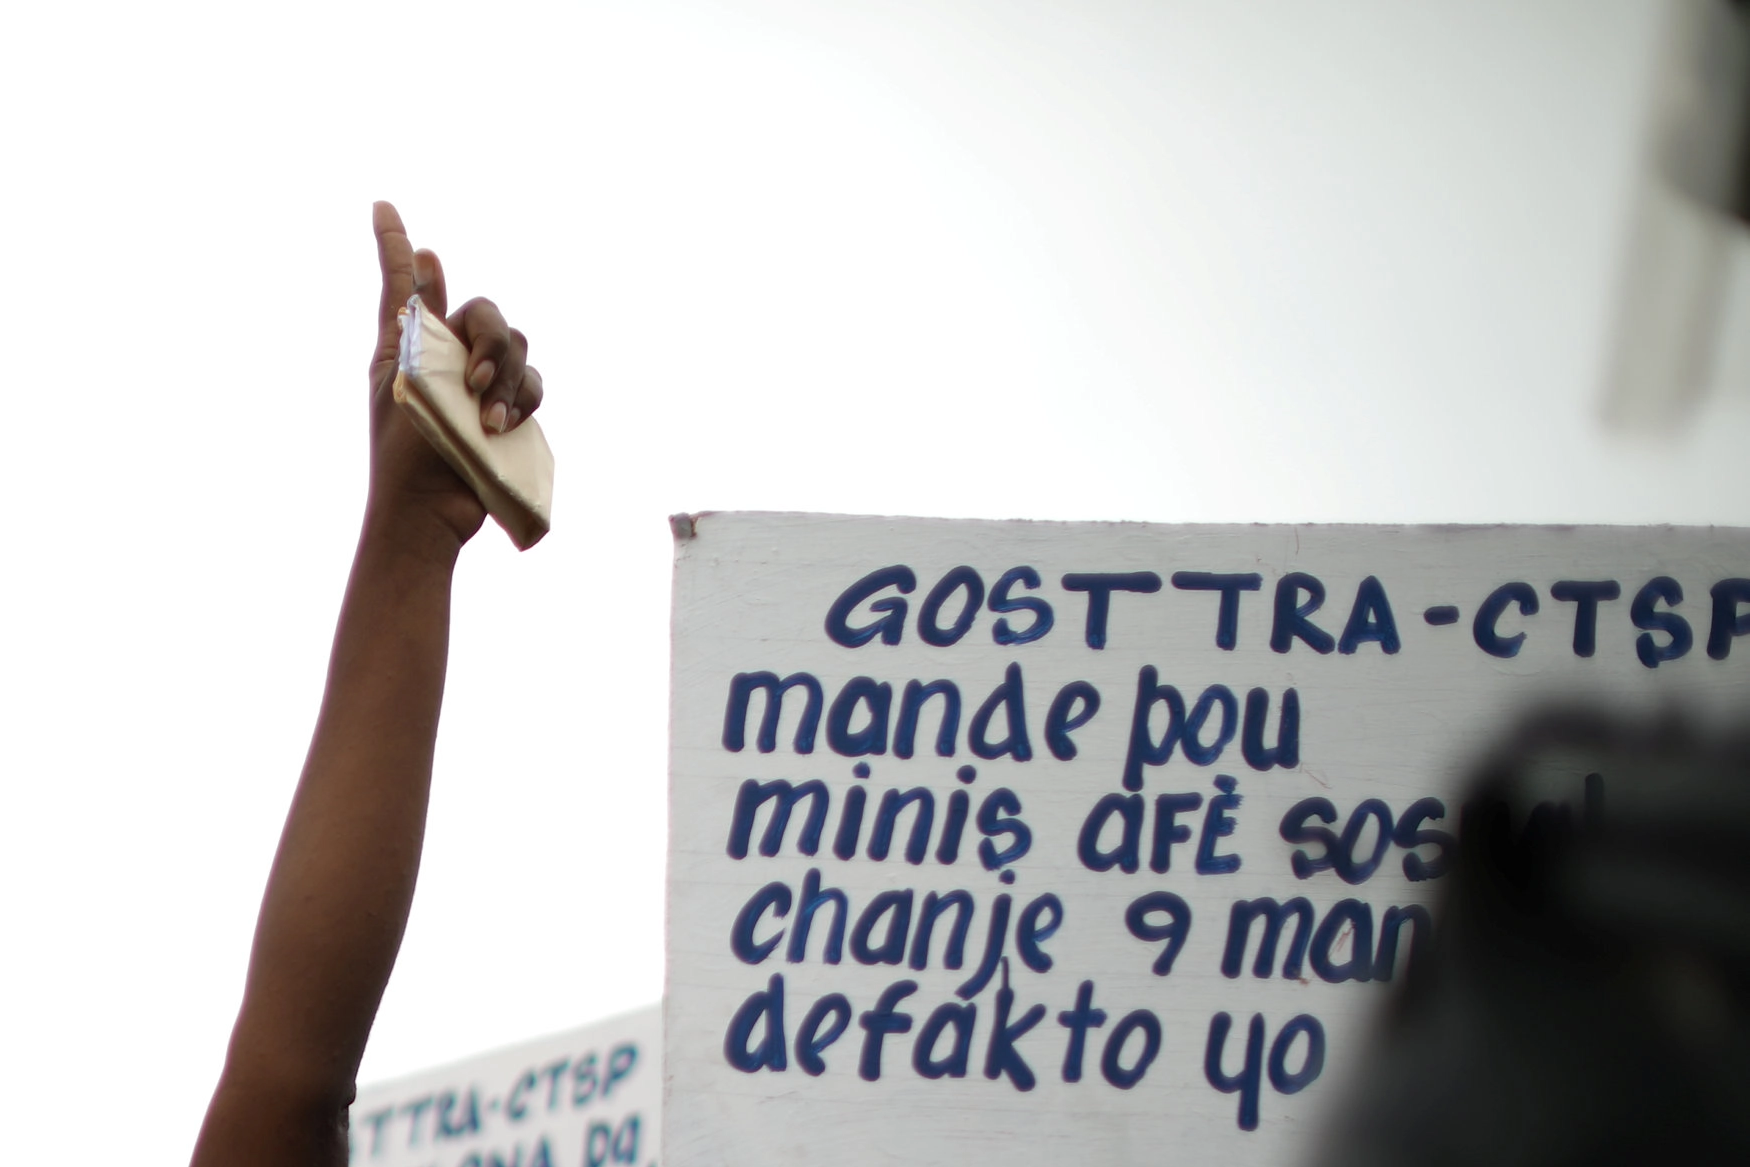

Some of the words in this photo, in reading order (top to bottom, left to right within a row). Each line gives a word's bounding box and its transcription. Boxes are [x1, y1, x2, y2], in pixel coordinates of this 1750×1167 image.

[721, 661, 1102, 763] mande
[1122, 663, 1301, 792] pou
[725, 760, 1033, 871] minis
[730, 866, 1065, 1001] chanje
[1124, 889, 1193, 977] 9
[1221, 896, 1436, 984] man
[723, 956, 1163, 1093] defakto
[1204, 1010, 1327, 1132] yo
